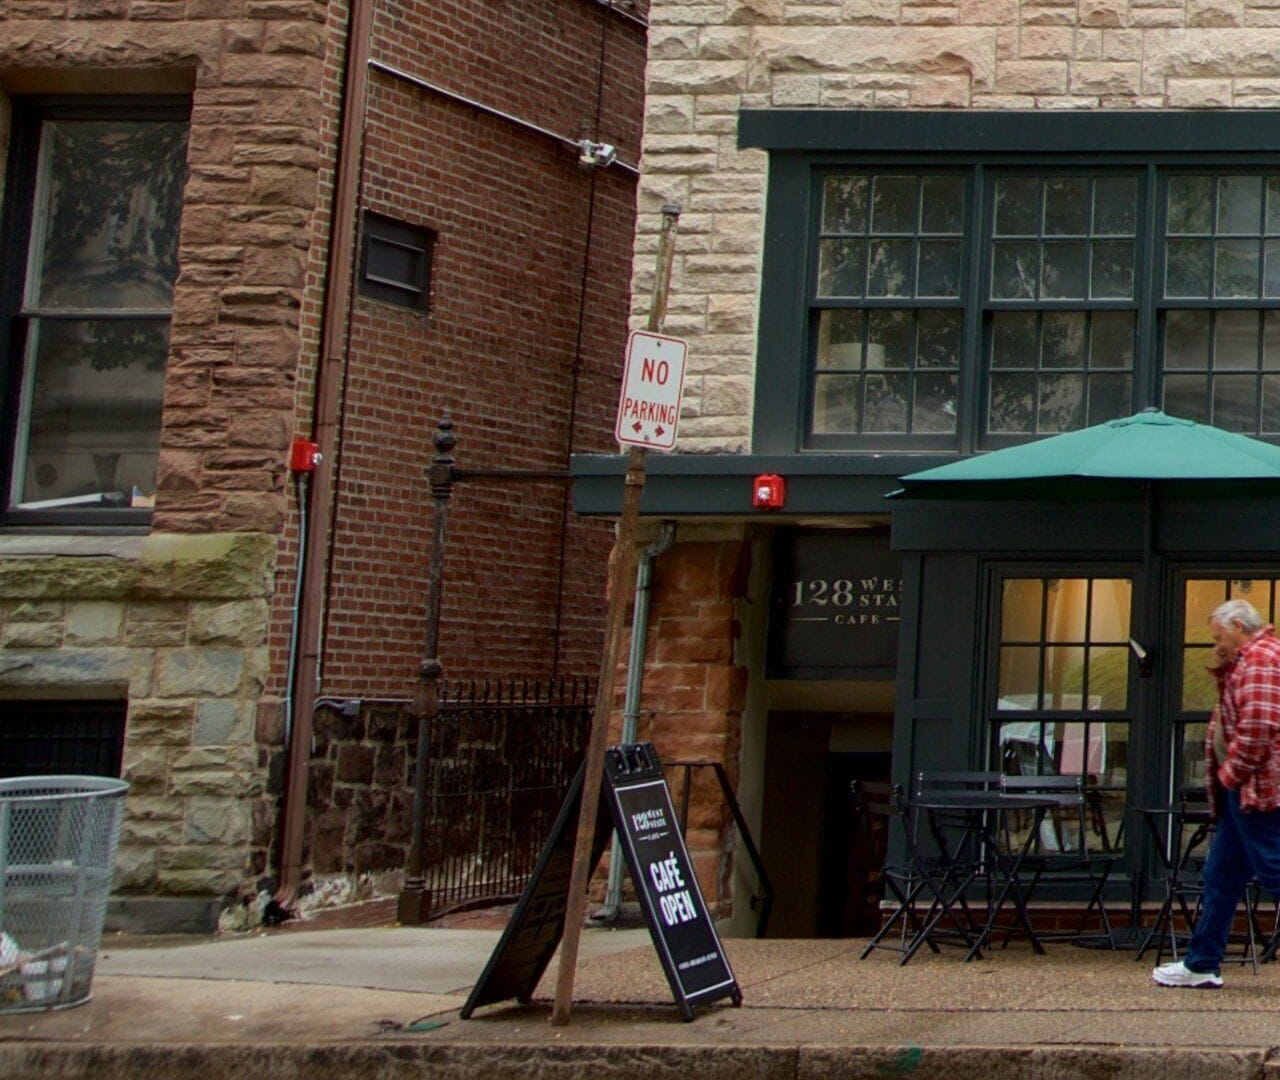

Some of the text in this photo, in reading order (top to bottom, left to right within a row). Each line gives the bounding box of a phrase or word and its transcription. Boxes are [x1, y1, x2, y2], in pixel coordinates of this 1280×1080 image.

[641, 357, 669, 386] NO
[624, 398, 676, 425] PARKING
[793, 576, 902, 607] 128 WE
[859, 593, 898, 607] STA
[834, 614, 881, 625] CAFE
[631, 807, 664, 832] 128 WEST
[649, 818, 666, 828] STATE
[650, 851, 685, 893] CAFÉ
[660, 889, 698, 927] OPEN
